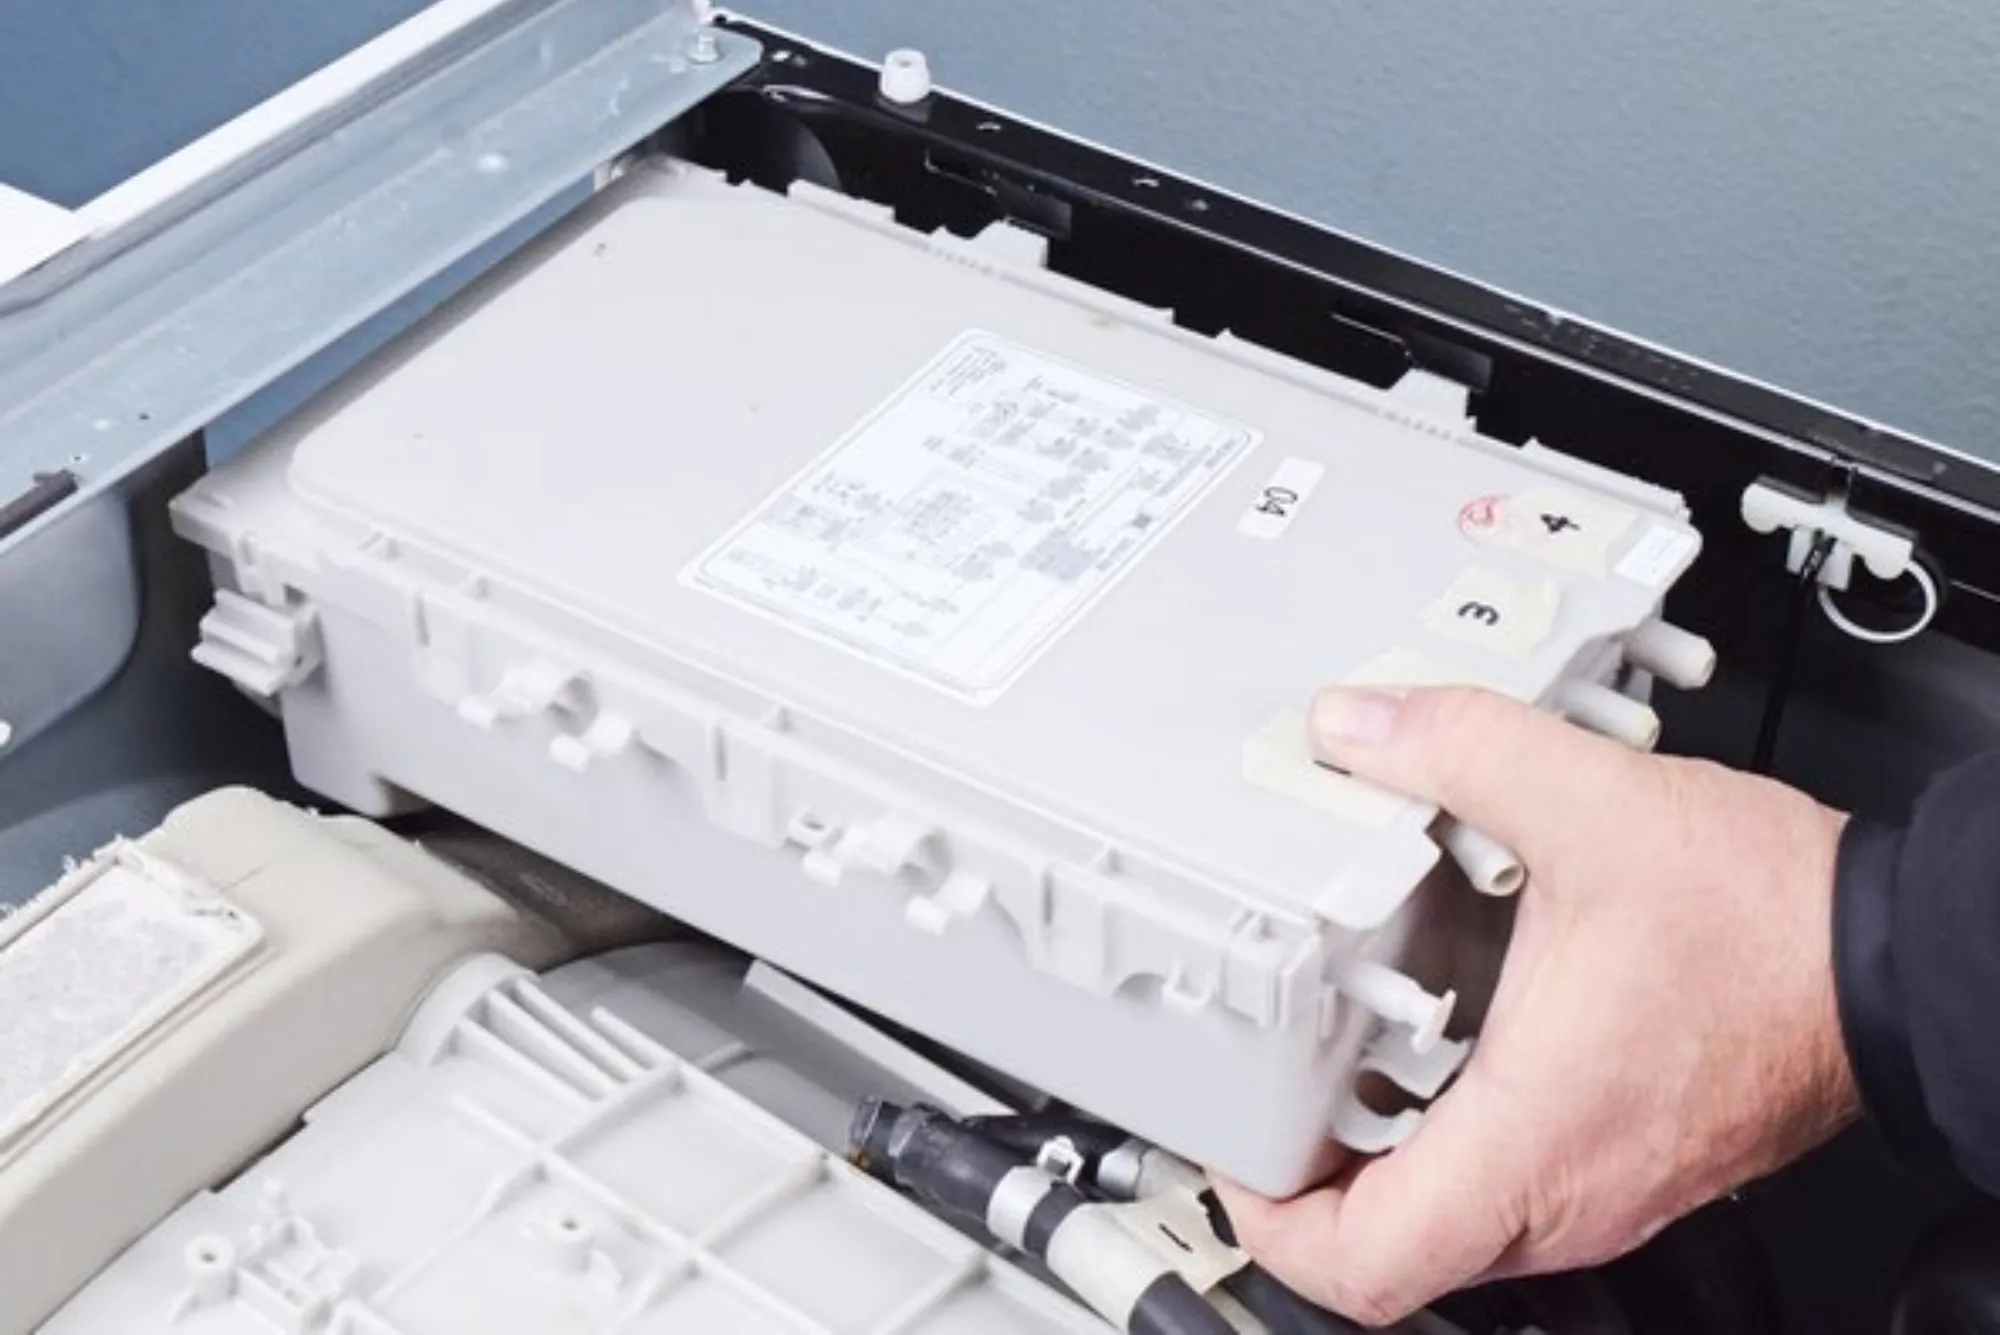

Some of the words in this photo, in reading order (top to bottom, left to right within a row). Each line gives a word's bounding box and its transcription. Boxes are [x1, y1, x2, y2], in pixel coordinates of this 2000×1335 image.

[1255, 486, 1298, 517] 04
[1539, 512, 1580, 534] 4
[1457, 601, 1499, 625] 3
